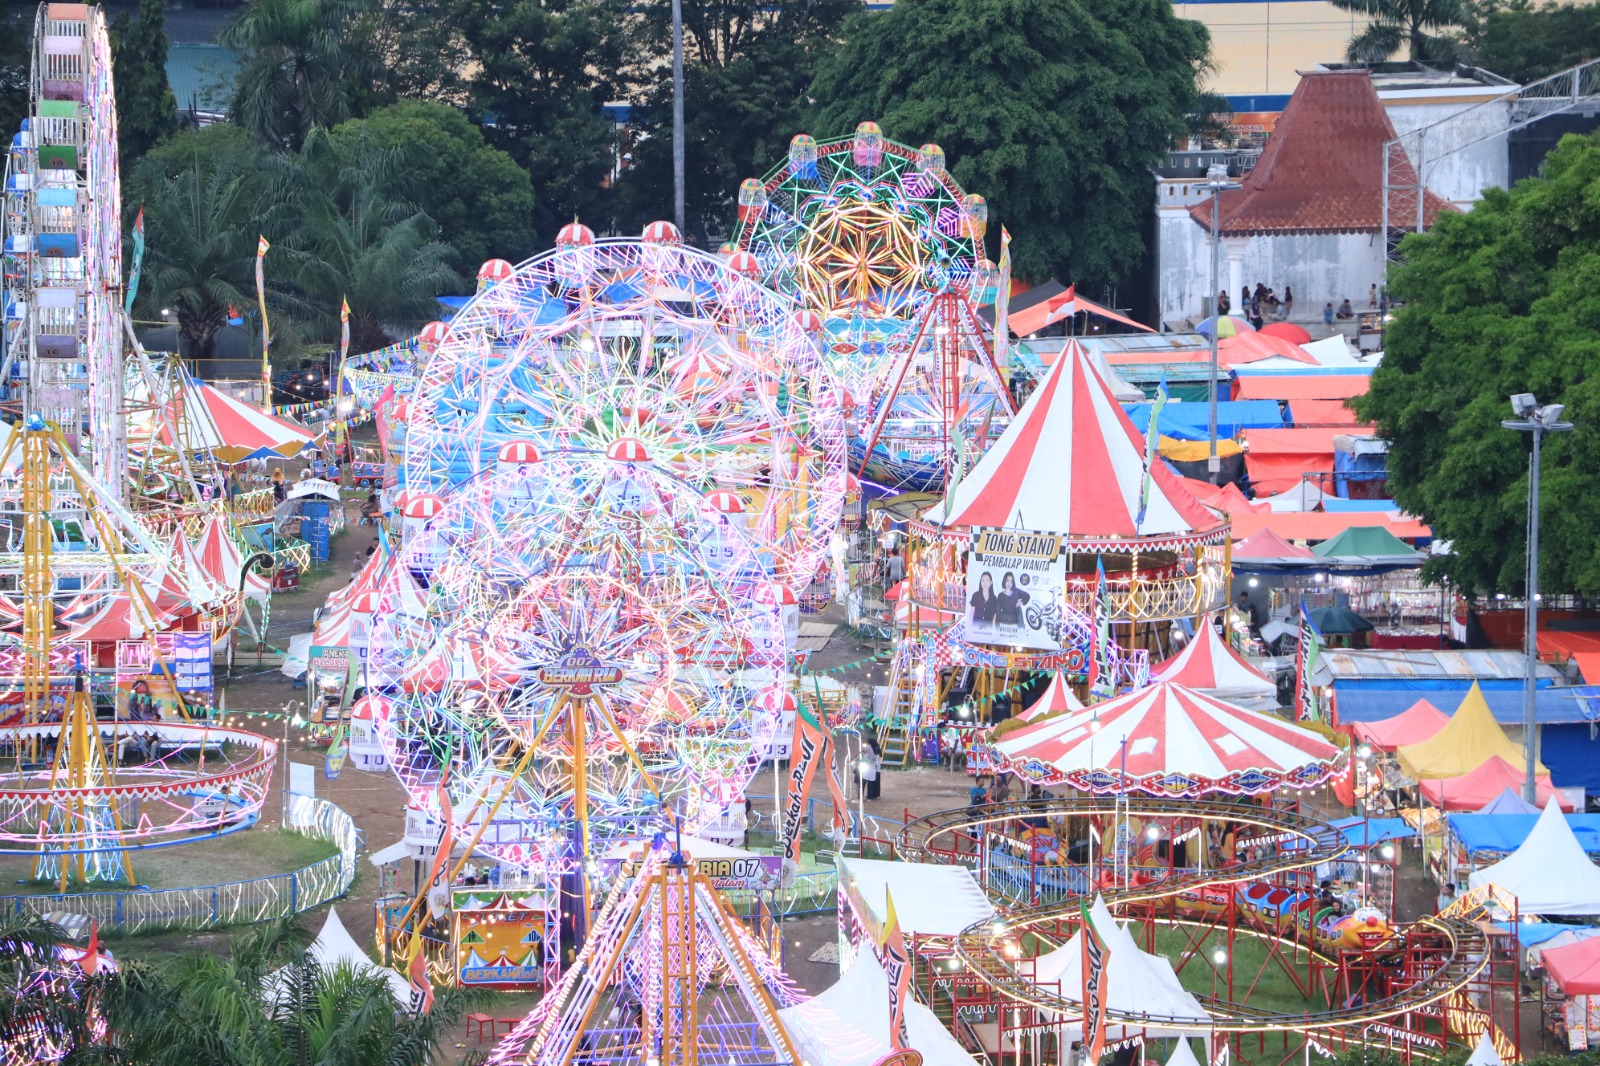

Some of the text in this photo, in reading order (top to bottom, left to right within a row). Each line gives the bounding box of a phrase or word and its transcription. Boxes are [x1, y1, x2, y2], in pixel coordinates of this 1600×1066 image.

[984, 532, 1055, 556] TONG STAND
[983, 554, 1050, 572] PEMBALAP WANITA
[566, 657, 595, 666] 007
[1013, 649, 1085, 672] STAND
[543, 668, 593, 683] BERKAH
[926, 638, 936, 704] ATRAKSI
[364, 754, 385, 766] 10
[699, 858, 761, 878] RIA 07
